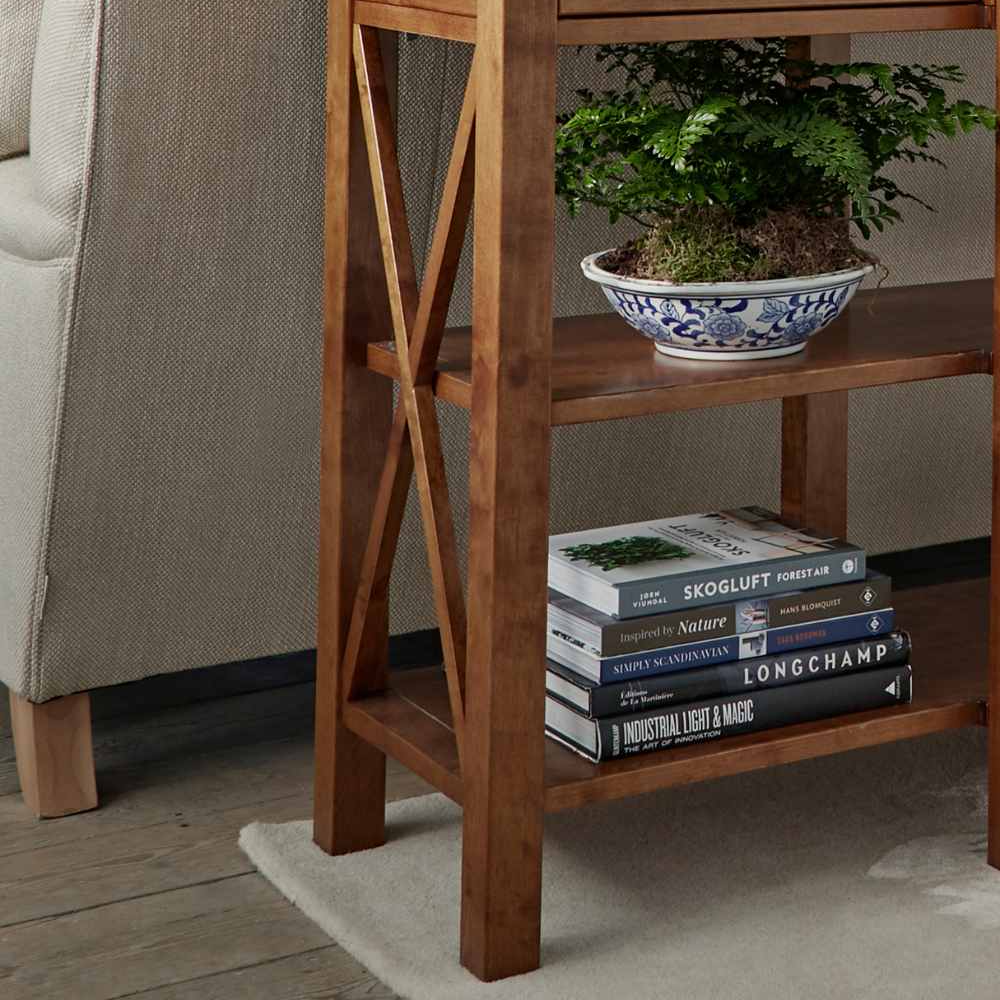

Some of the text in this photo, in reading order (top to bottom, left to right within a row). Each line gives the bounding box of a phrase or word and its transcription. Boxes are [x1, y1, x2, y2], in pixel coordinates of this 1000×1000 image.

[684, 566, 830, 600] SKOGLUFT FOREST AIR
[780, 598, 841, 615] HANS BLOMQUIST
[620, 616, 727, 643] Inspired by Nature
[613, 645, 730, 675] SIMPLY SCANDINAVIAN
[744, 644, 887, 685] LONGCHAMP
[623, 699, 754, 745] INDUSTRIAL LIGHT & MAGIC
[624, 730, 722, 754] THE ART OF INNOVATION
